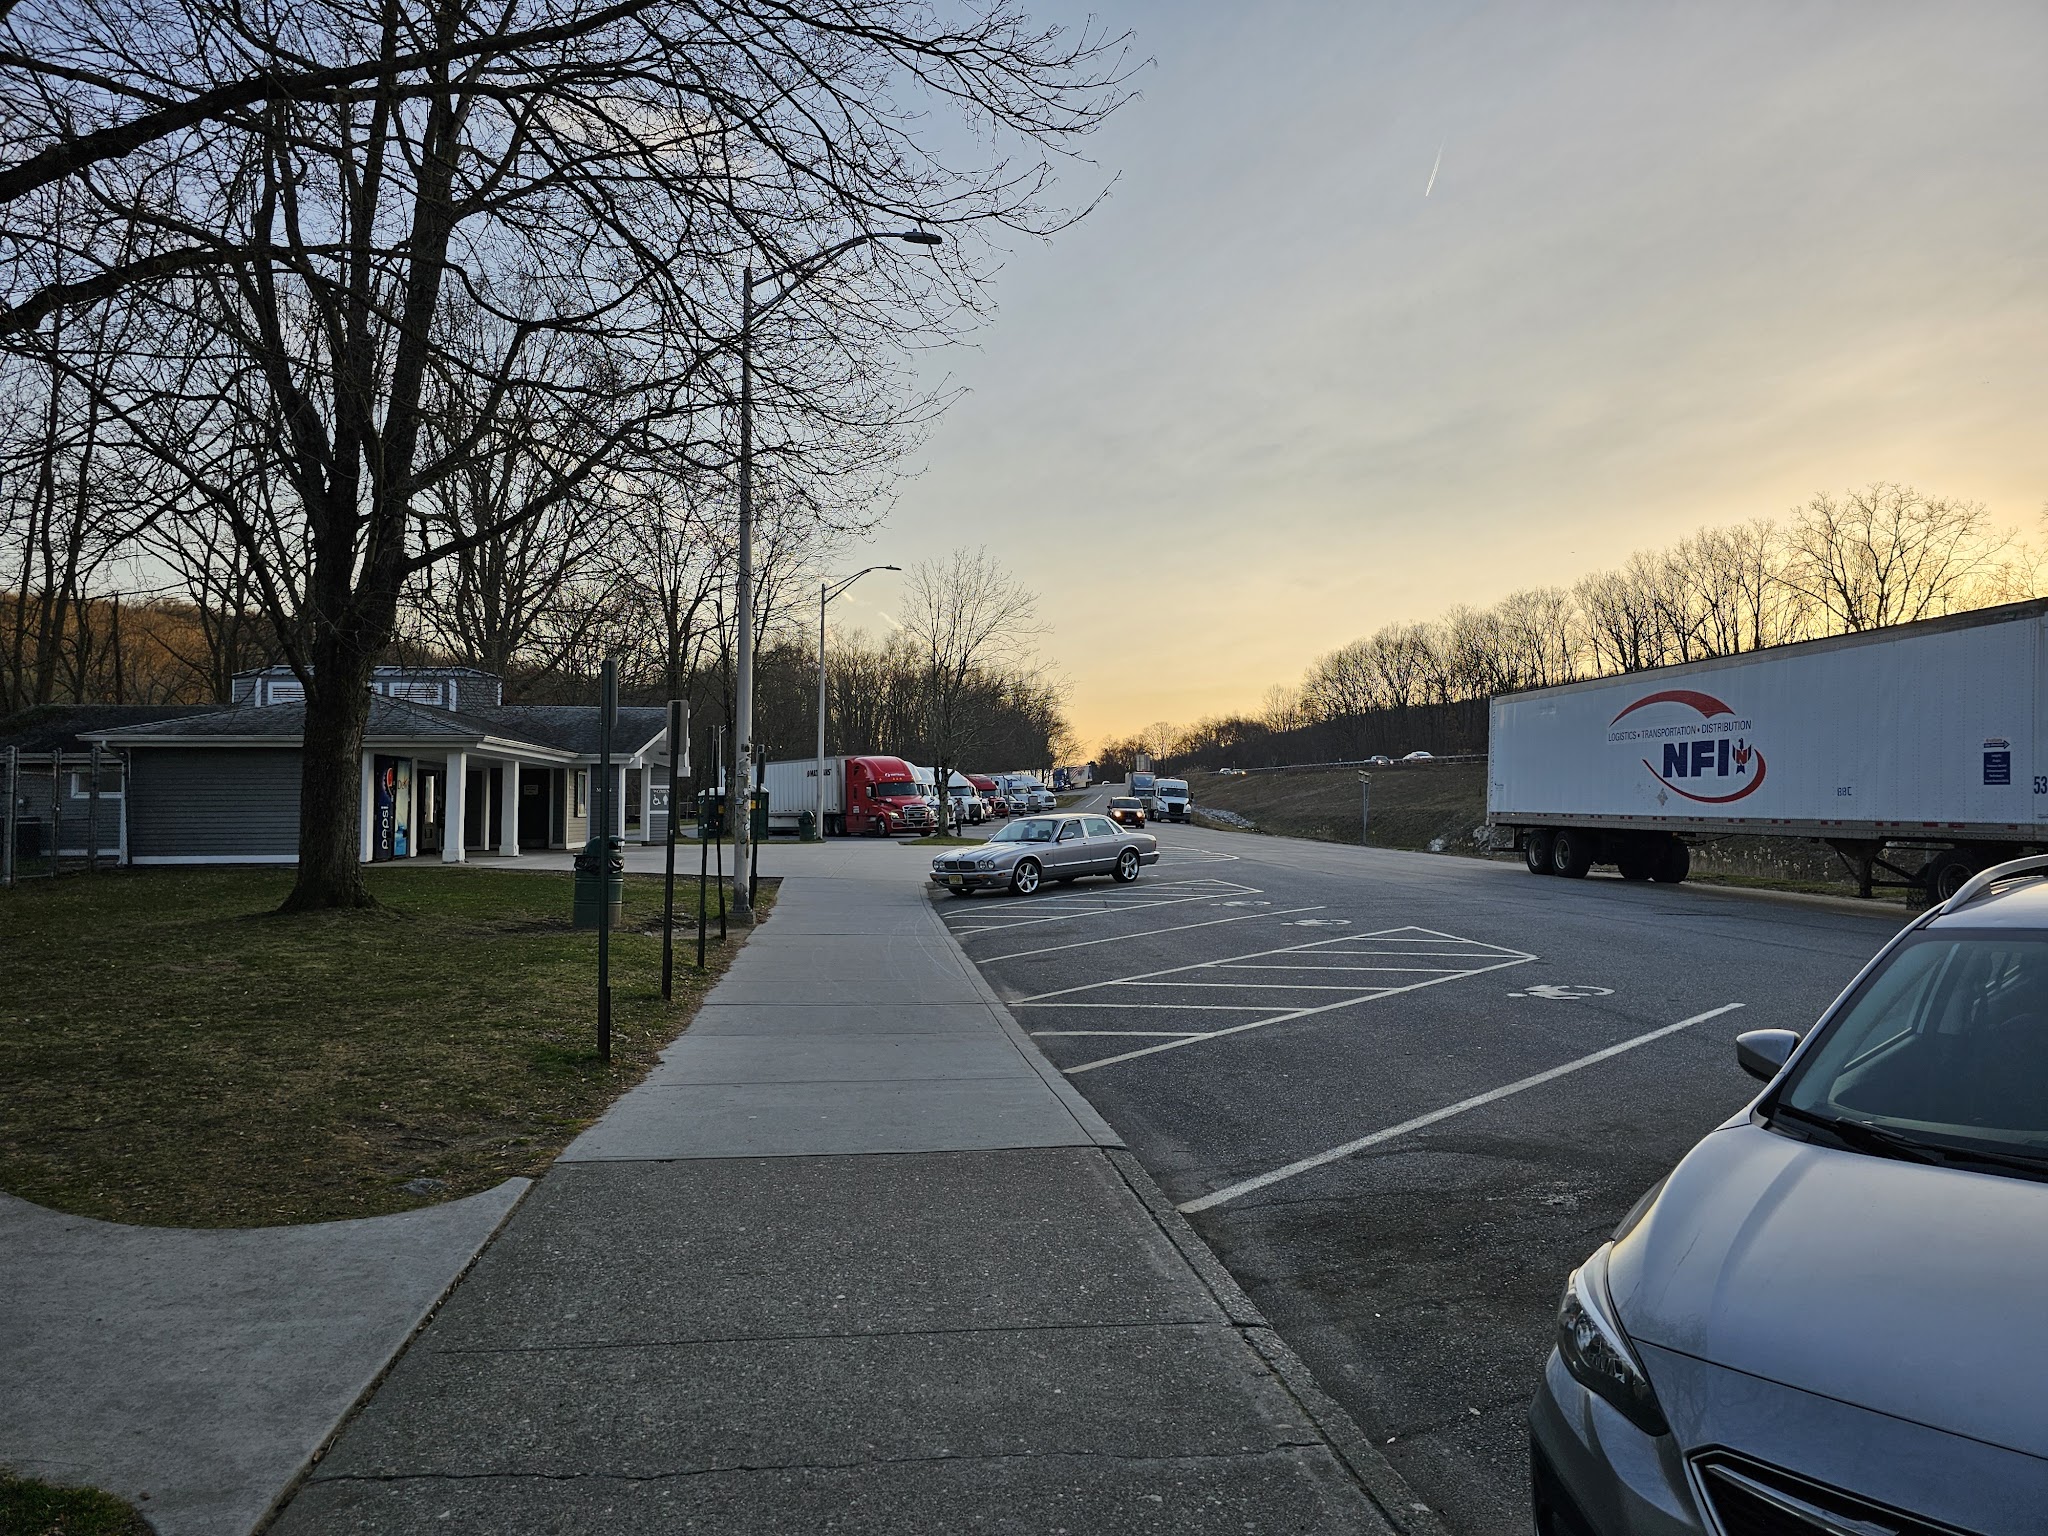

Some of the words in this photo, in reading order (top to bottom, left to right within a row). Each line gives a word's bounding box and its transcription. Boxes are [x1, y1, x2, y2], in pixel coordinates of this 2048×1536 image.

[1608, 731, 1637, 742] LOGISTICS
[1641, 725, 1696, 739] TRANSPORTATION
[1701, 720, 1752, 734] DISTRIBUTION
[1663, 739, 1730, 778] NFI
[2033, 775, 2048, 794] 53
[380, 805, 389, 850] pepsi
